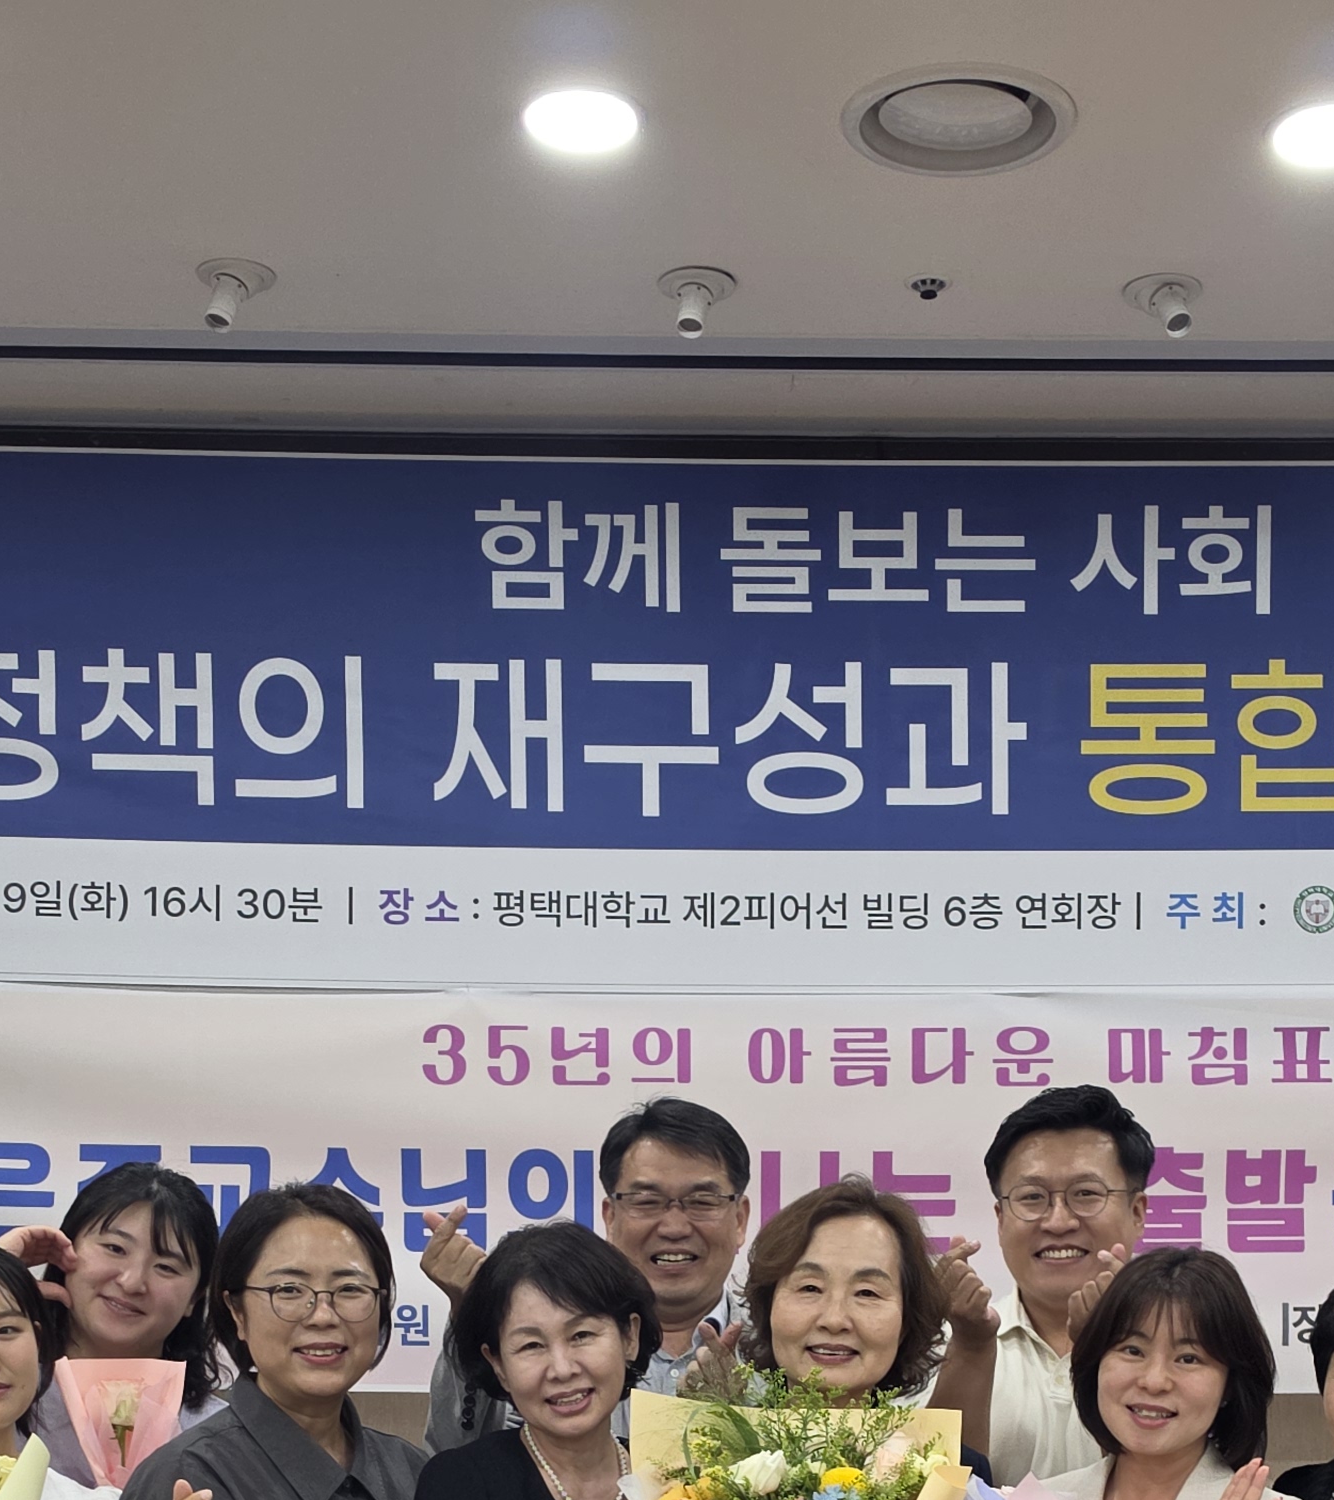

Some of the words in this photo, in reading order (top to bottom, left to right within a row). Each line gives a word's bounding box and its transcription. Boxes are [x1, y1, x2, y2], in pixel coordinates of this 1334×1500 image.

[475, 499, 680, 613] 함께
[720, 506, 1037, 614] 돌보는
[1070, 504, 1272, 616] 사회
[433, 658, 1028, 818] 재구성과
[3, 879, 129, 922] 9일(화)
[143, 884, 221, 922] 16시
[236, 886, 323, 923] 30분
[492, 889, 671, 929] 평택대학교
[682, 891, 848, 930] 제2피어선
[862, 892, 929, 930] 빌딩
[943, 892, 1004, 930] 6층
[1015, 892, 1122, 931] 연회장
[421, 1023, 692, 1087] 35년의
[747, 1025, 1055, 1089] 아름다운
